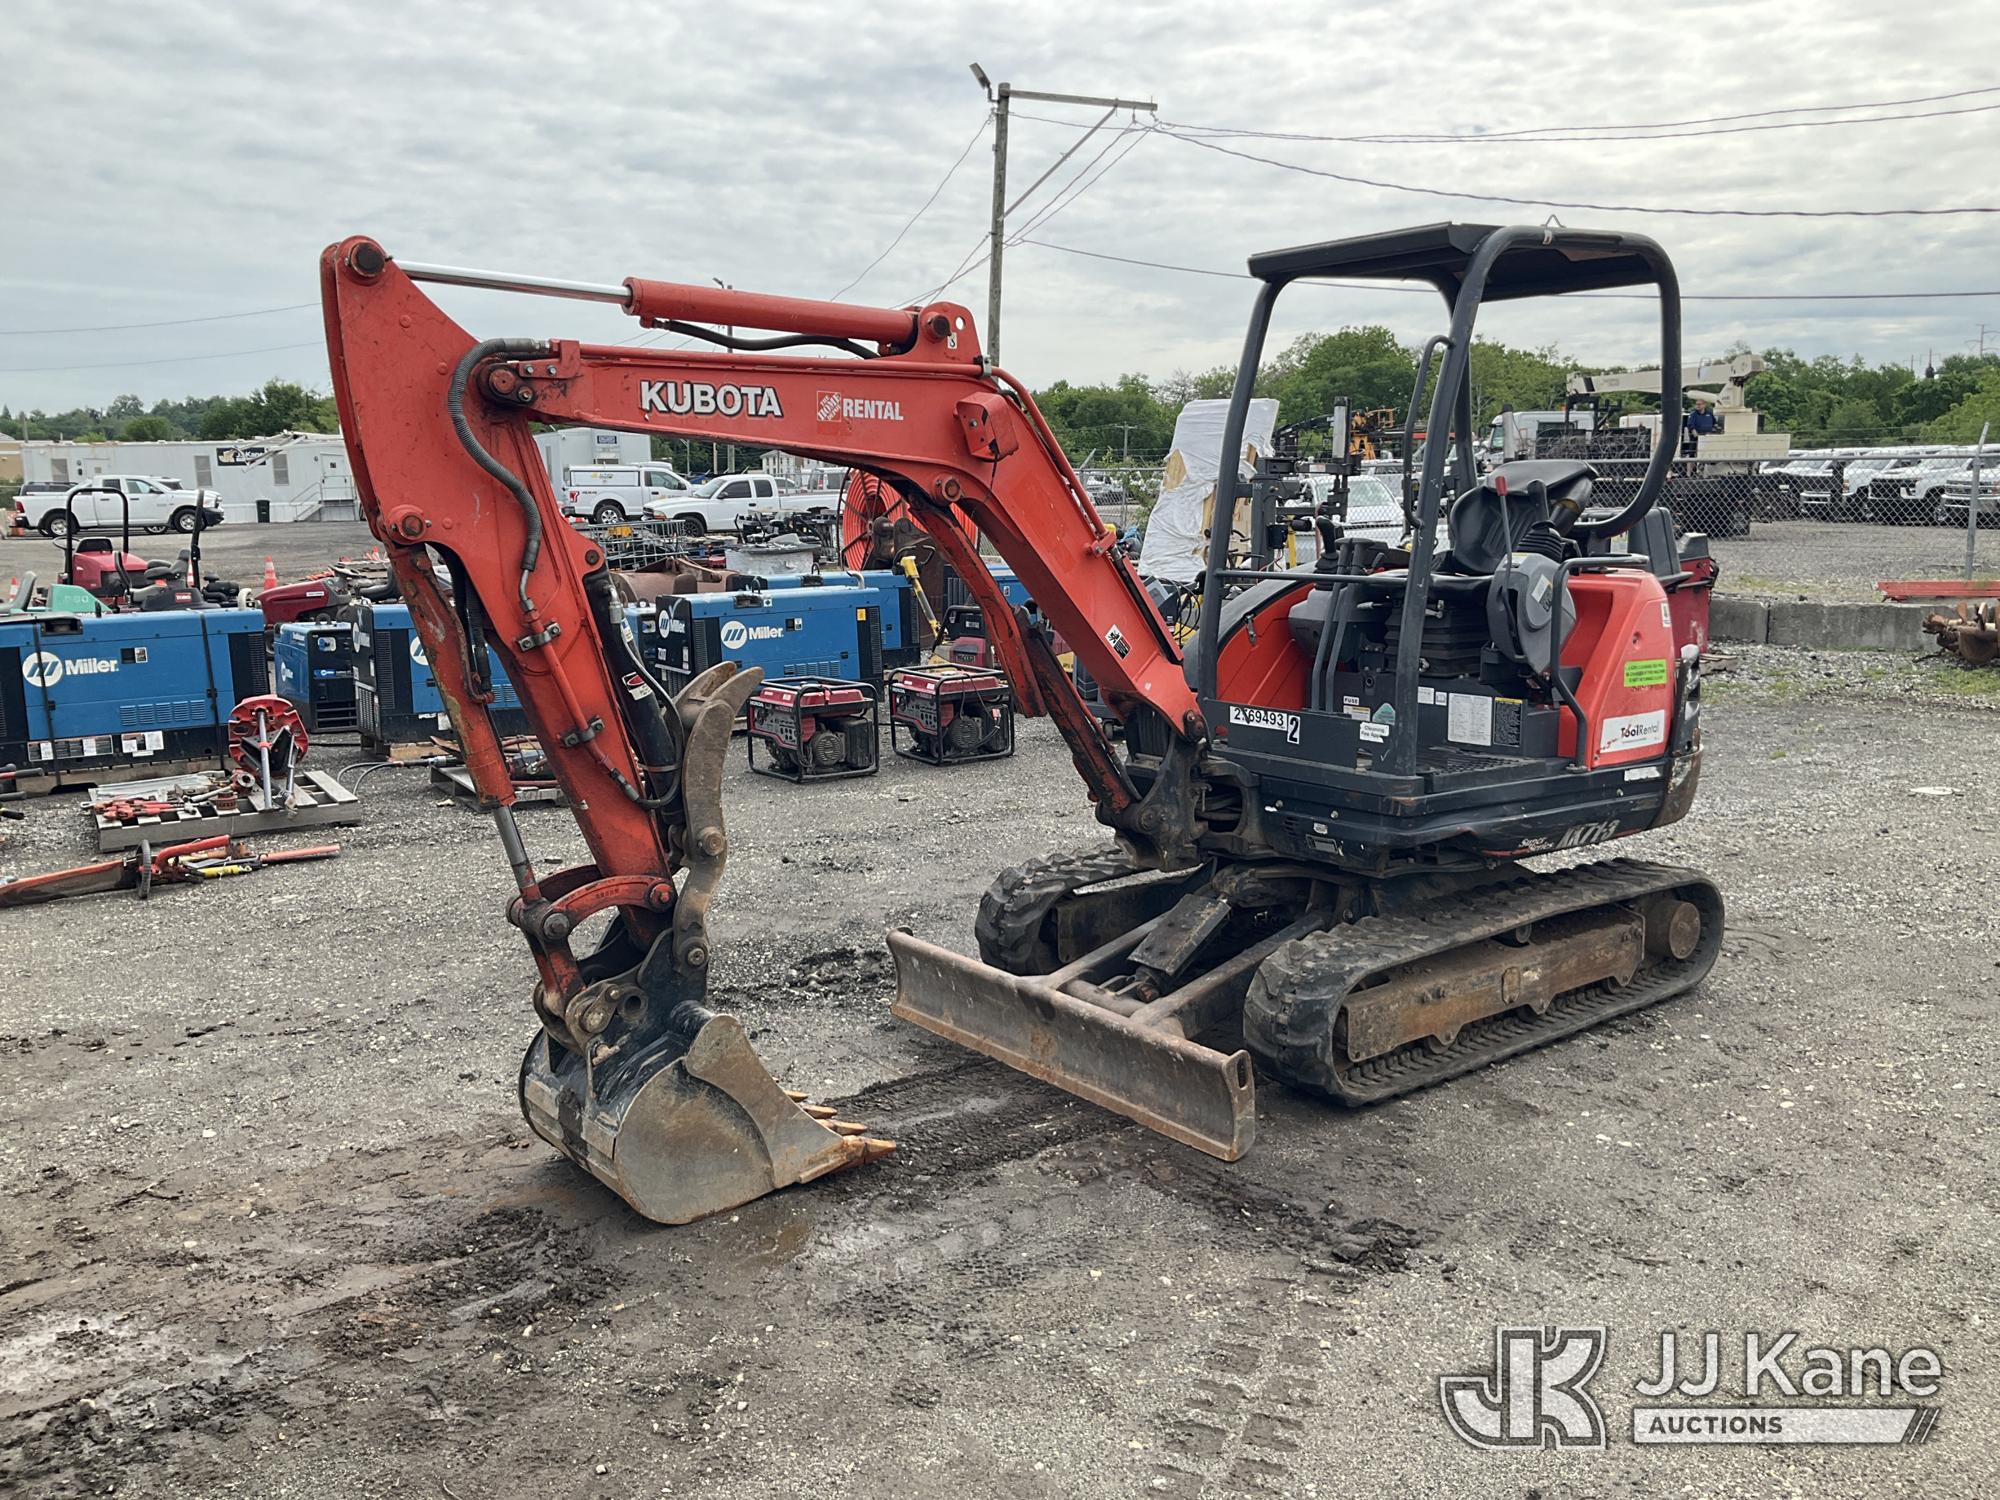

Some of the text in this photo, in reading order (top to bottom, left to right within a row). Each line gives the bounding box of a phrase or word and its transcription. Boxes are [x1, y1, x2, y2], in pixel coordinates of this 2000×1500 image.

[640, 381, 784, 418] KUBOTA
[817, 392, 904, 421] HOME RENTAL
[748, 626, 784, 640] Miller
[65, 657, 119, 676] Miller
[1234, 708, 1299, 742] 269493 2
